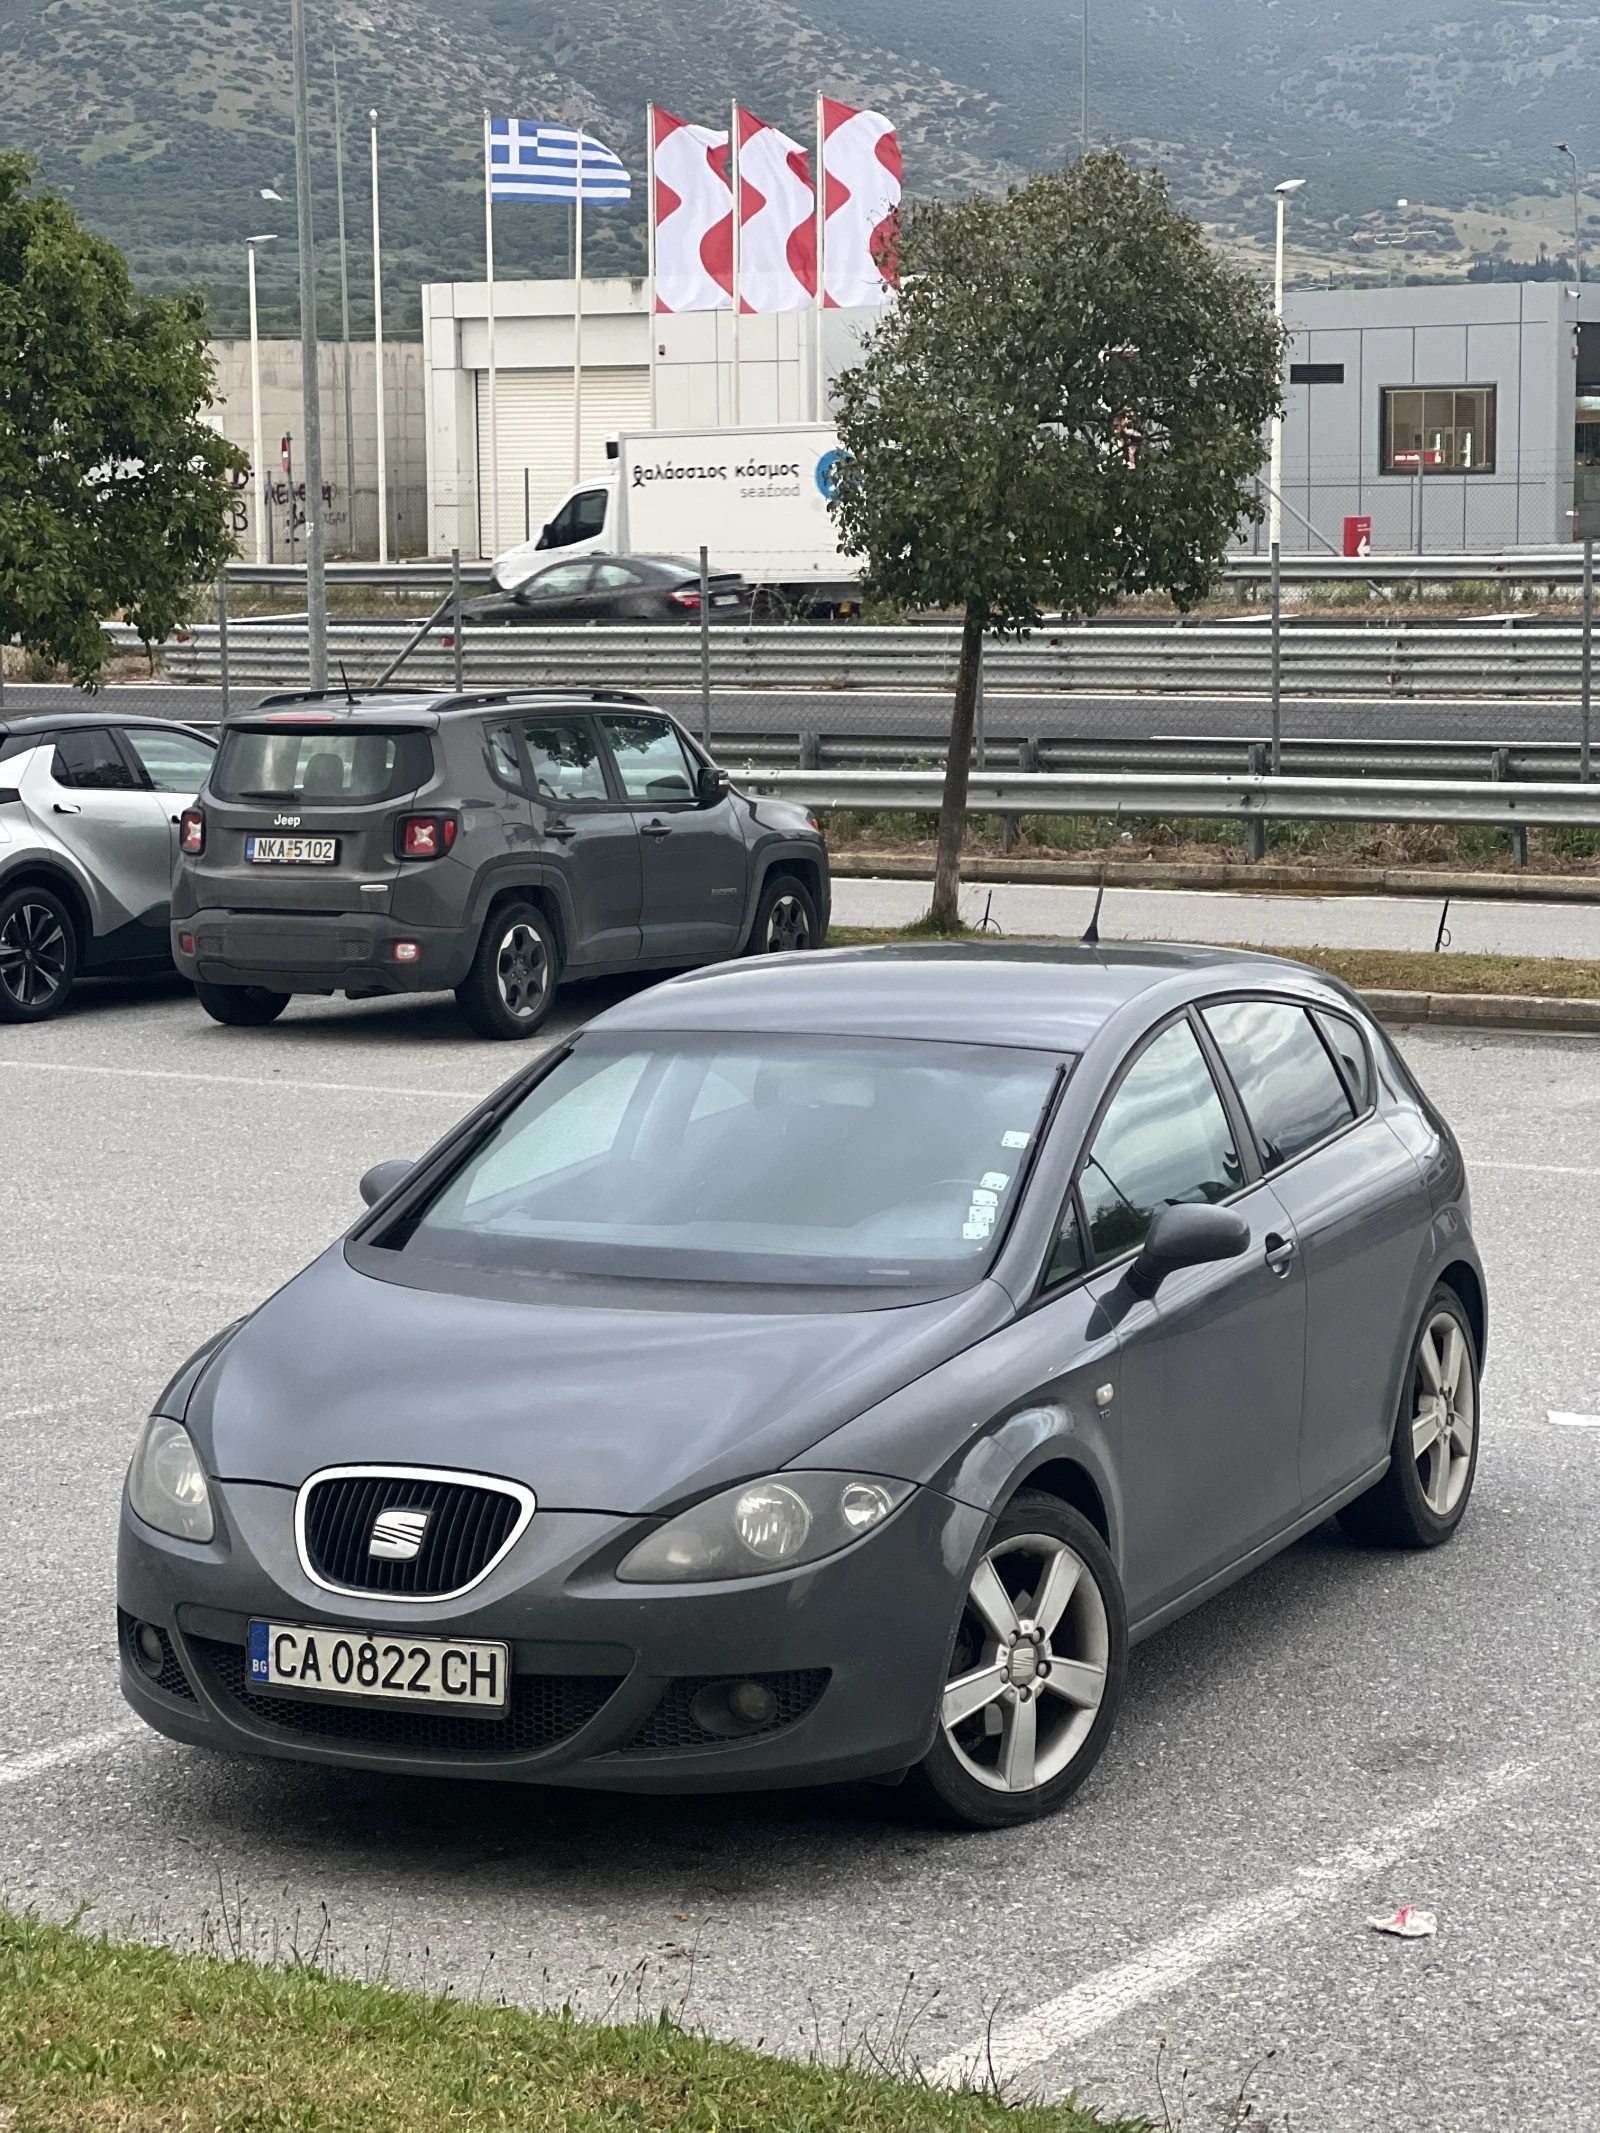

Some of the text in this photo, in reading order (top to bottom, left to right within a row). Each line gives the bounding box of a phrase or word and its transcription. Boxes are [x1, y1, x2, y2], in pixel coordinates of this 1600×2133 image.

[632, 458, 799, 487] θαλάσσιος κόσμος
[740, 483, 800, 498] seafood
[274, 813, 301, 827] Jeep
[258, 839, 333, 859] NKA 5102
[252, 1658, 268, 1673] BG
[274, 1633, 497, 1697] CA 0822 CH
